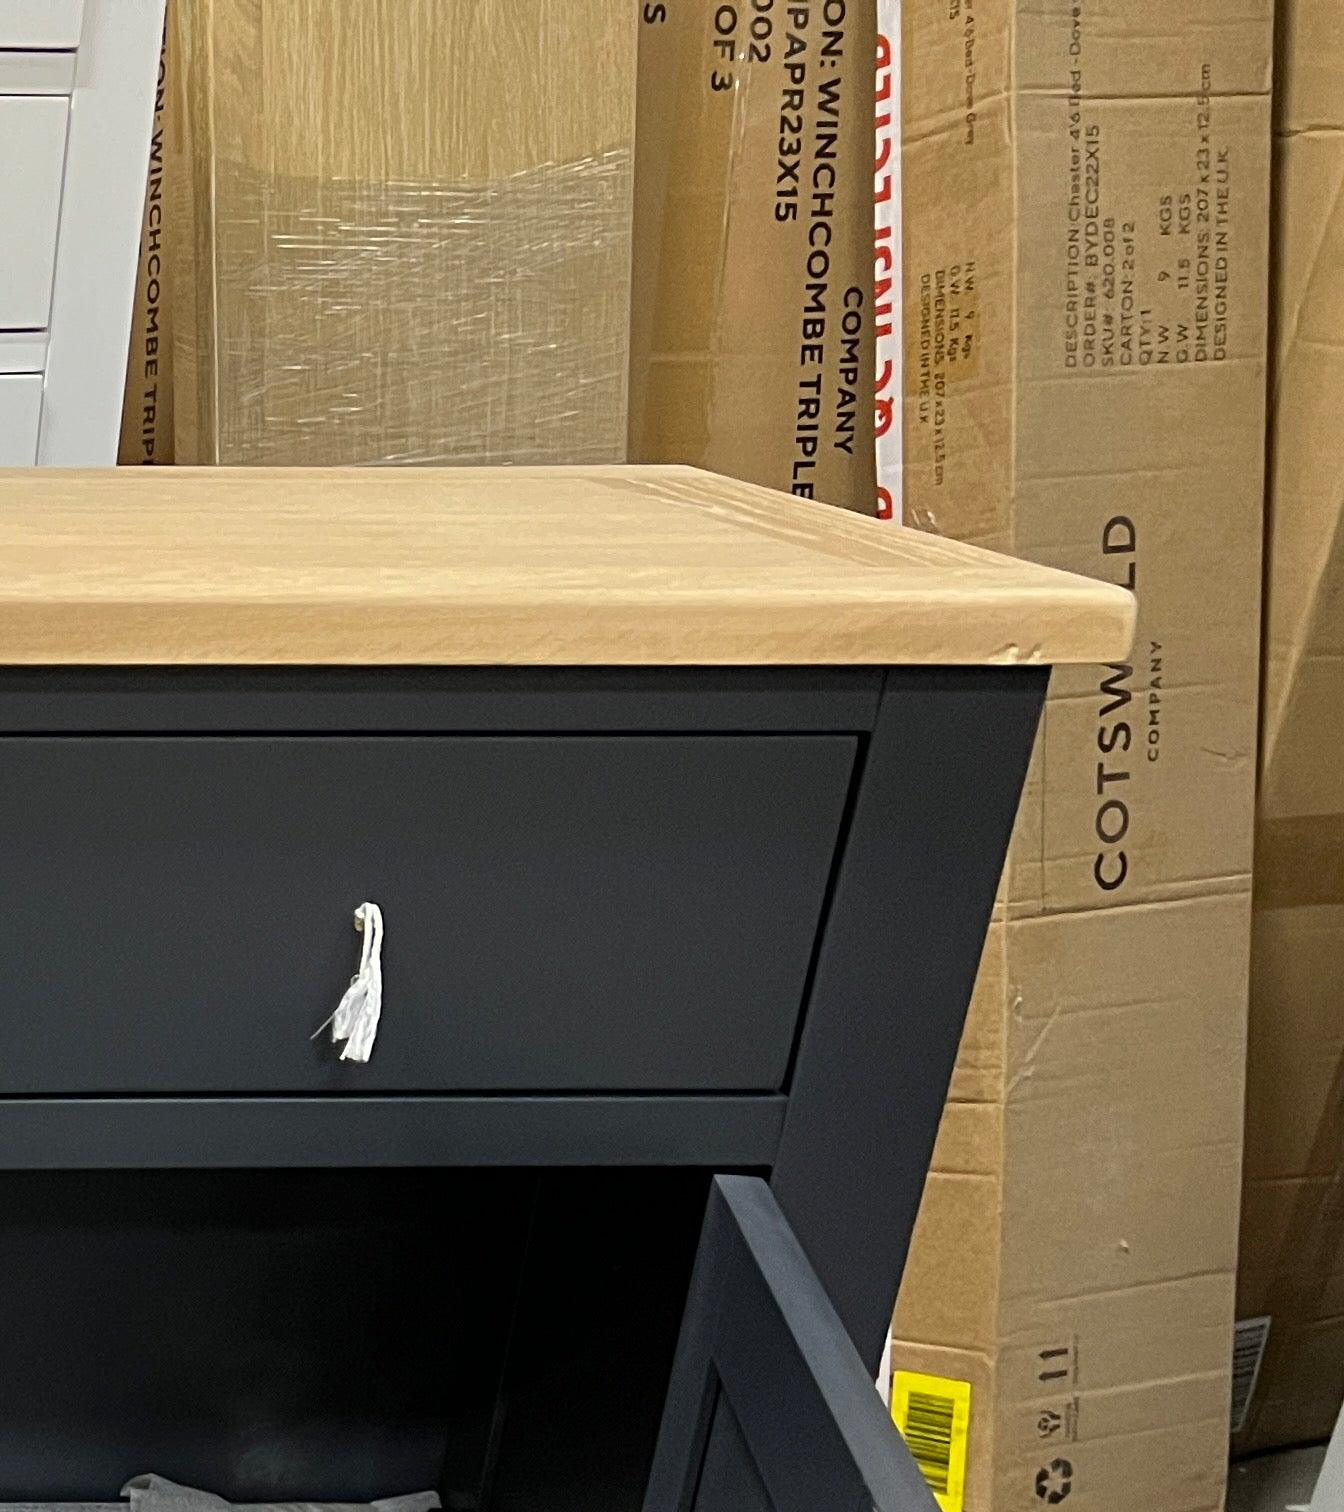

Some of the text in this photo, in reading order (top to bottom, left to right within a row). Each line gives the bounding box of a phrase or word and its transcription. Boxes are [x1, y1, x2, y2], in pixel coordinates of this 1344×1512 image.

[711, 5, 738, 92] OF 3
[1085, 123, 1101, 266] BYDEC22X15
[1195, 147, 1211, 171] 23
[1196, 188, 1211, 223] 207
[1215, 187, 1230, 226] THE
[144, 129, 165, 378] WINCHCOMBE
[799, 77, 842, 366] WINCHCOMBE
[1158, 195, 1173, 236] KGS
[1178, 193, 1193, 234] KGS
[1214, 231, 1229, 254] IN
[1213, 256, 1229, 362] DESIGNED
[833, 286, 865, 455] COMPANY
[791, 373, 823, 501] TRIPLE
[1093, 514, 1137, 891] COTSWLD
[1146, 640, 1164, 763] COMPANY
